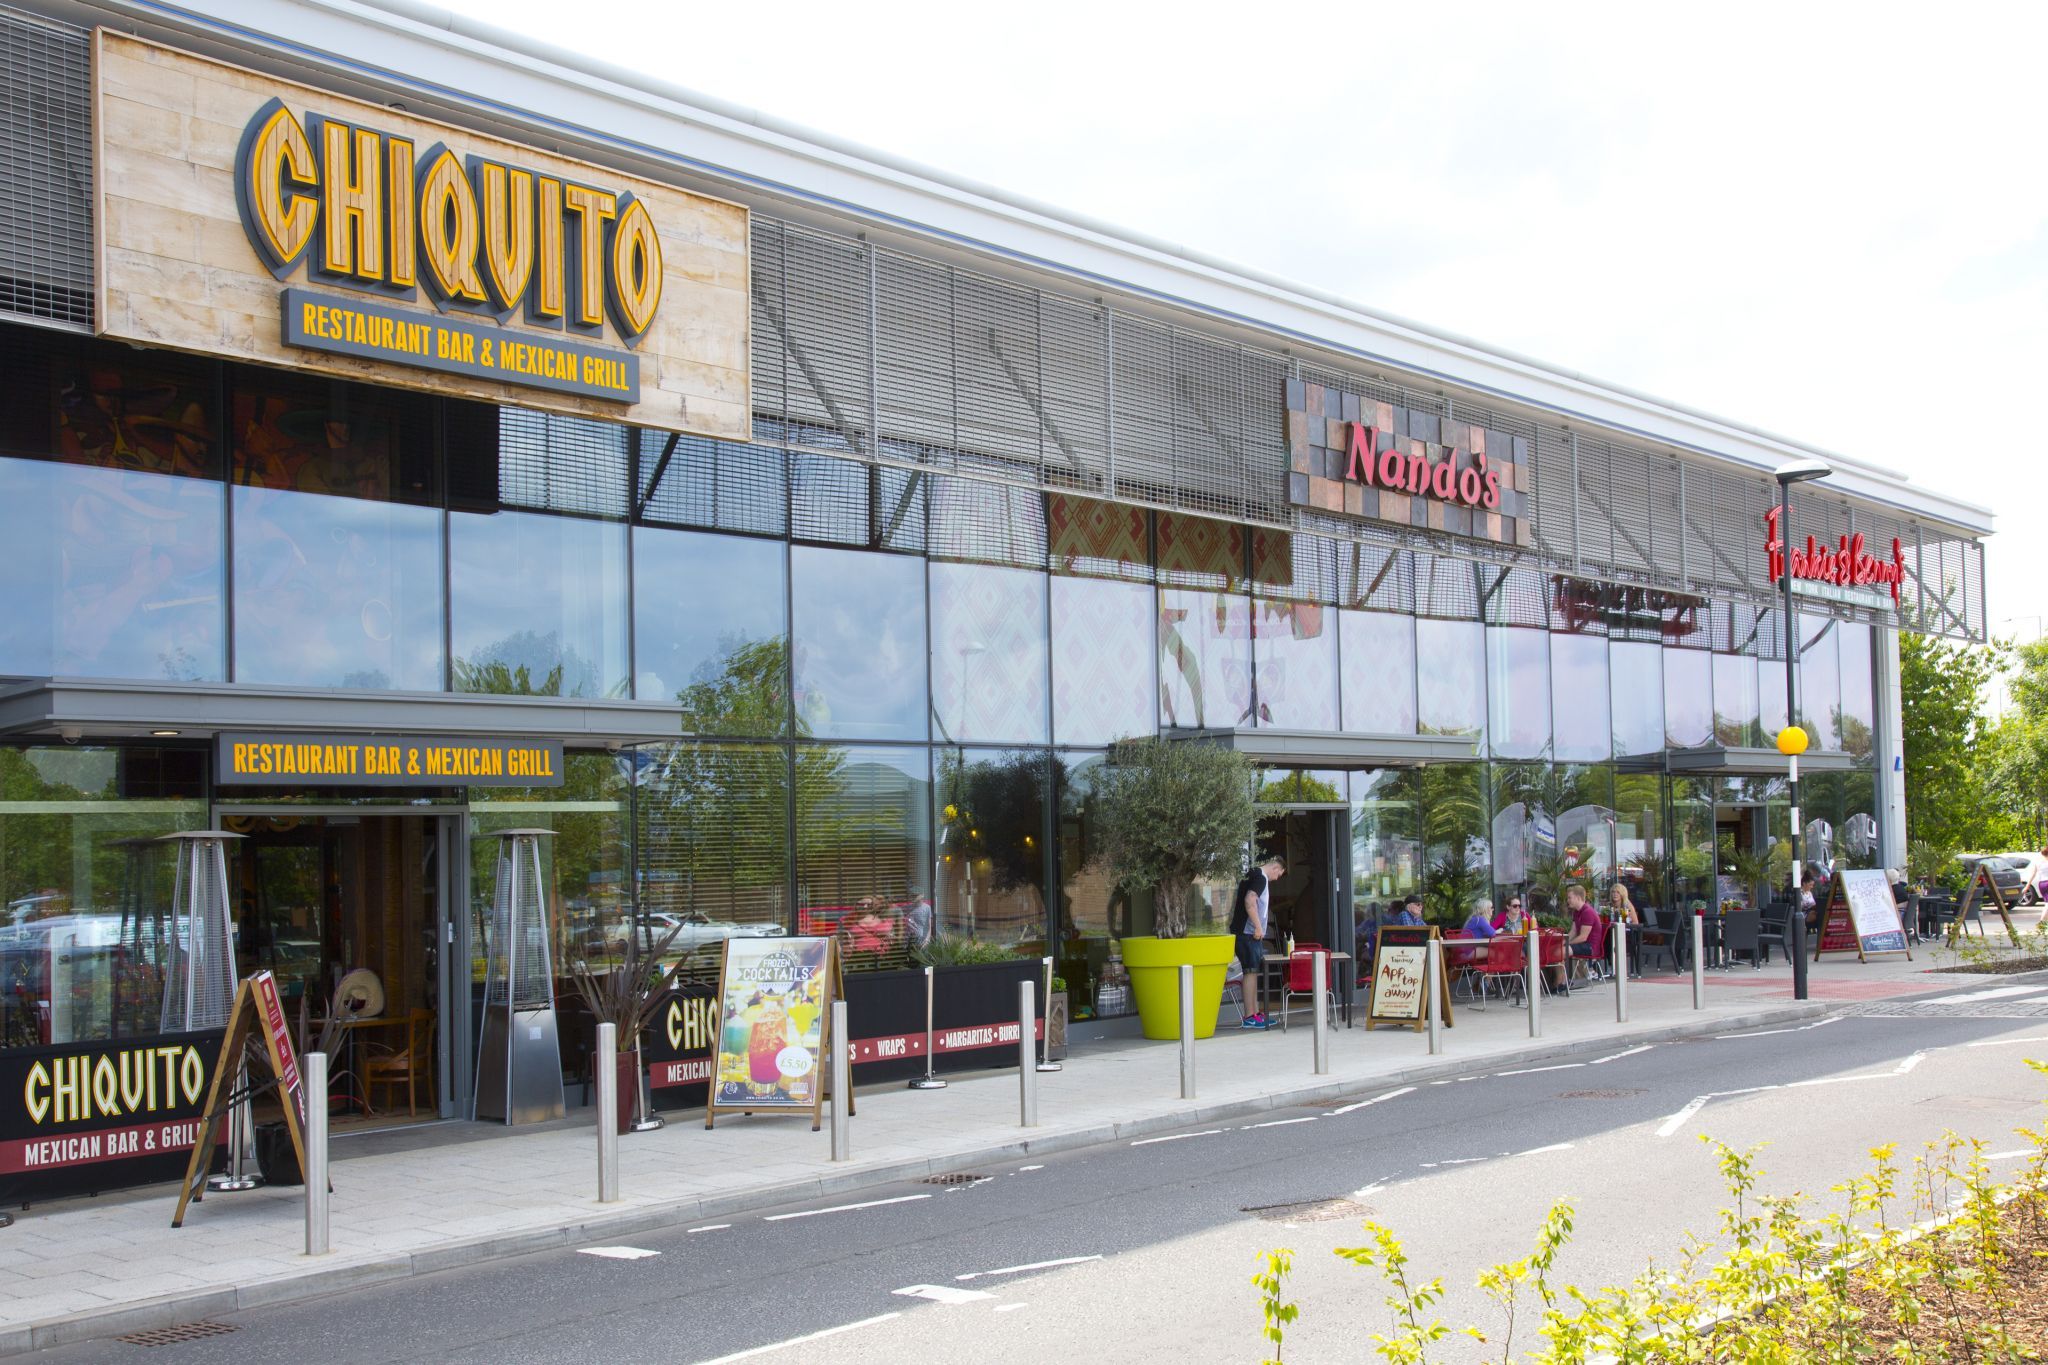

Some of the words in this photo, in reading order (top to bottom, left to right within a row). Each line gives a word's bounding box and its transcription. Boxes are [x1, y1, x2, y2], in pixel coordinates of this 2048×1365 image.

[246, 100, 664, 340] CHIQUITO
[303, 302, 432, 356] RESTAURANT
[437, 328, 475, 364] BAR
[480, 338, 495, 367] &
[500, 340, 578, 382] MEXICAN
[583, 355, 630, 391] GRILL
[1345, 421, 1500, 509] Nando's
[234, 743, 358, 774] RESTAURANT
[364, 746, 401, 775] BAR
[407, 748, 421, 775] &
[426, 747, 503, 776] MEXICAN
[508, 748, 554, 777] GRILL
[743, 967, 809, 980] COCKTAILS
[763, 958, 790, 968] FROZEN
[1381, 964, 1406, 982] App
[1402, 975, 1419, 987] tap
[1384, 988, 1416, 1000] away!
[877, 1037, 906, 1057] WRAPS
[945, 1027, 993, 1049] MARGARITAS
[998, 1023, 1020, 1042] BURRI
[667, 1060, 712, 1083] MEXICAN
[25, 1045, 204, 1125] CHIQUITO
[25, 1135, 101, 1166] MEXICAN
[107, 1130, 139, 1156] BAR
[144, 1129, 156, 1150] &
